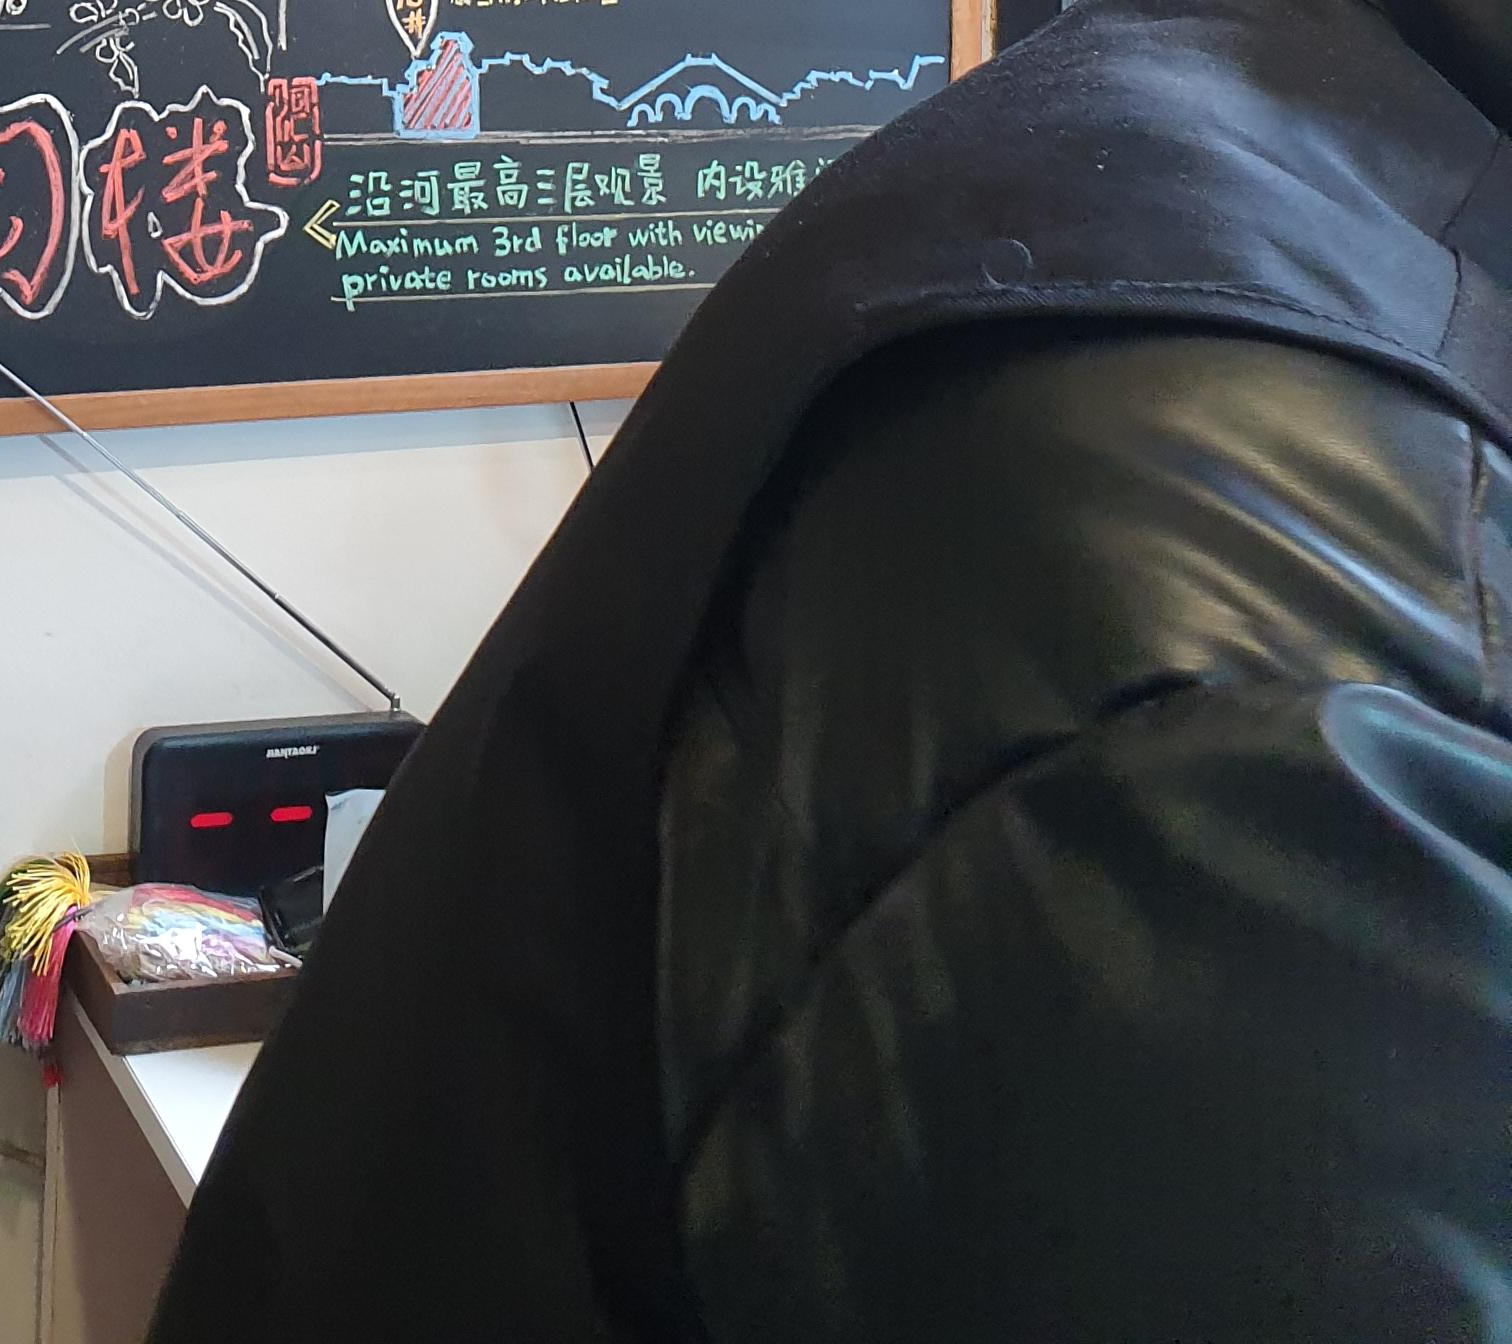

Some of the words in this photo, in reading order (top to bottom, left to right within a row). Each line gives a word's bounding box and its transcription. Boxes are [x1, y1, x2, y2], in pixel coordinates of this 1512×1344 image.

[346, 153, 667, 216] 沿河最高三层观景
[697, 157, 838, 201] 内设雅
[334, 227, 479, 259] Maximum
[492, 226, 542, 256] 3rd
[556, 224, 618, 255] floor
[629, 220, 683, 247] with
[341, 268, 451, 310] private
[468, 266, 548, 289] rooms
[564, 255, 695, 286] available.
